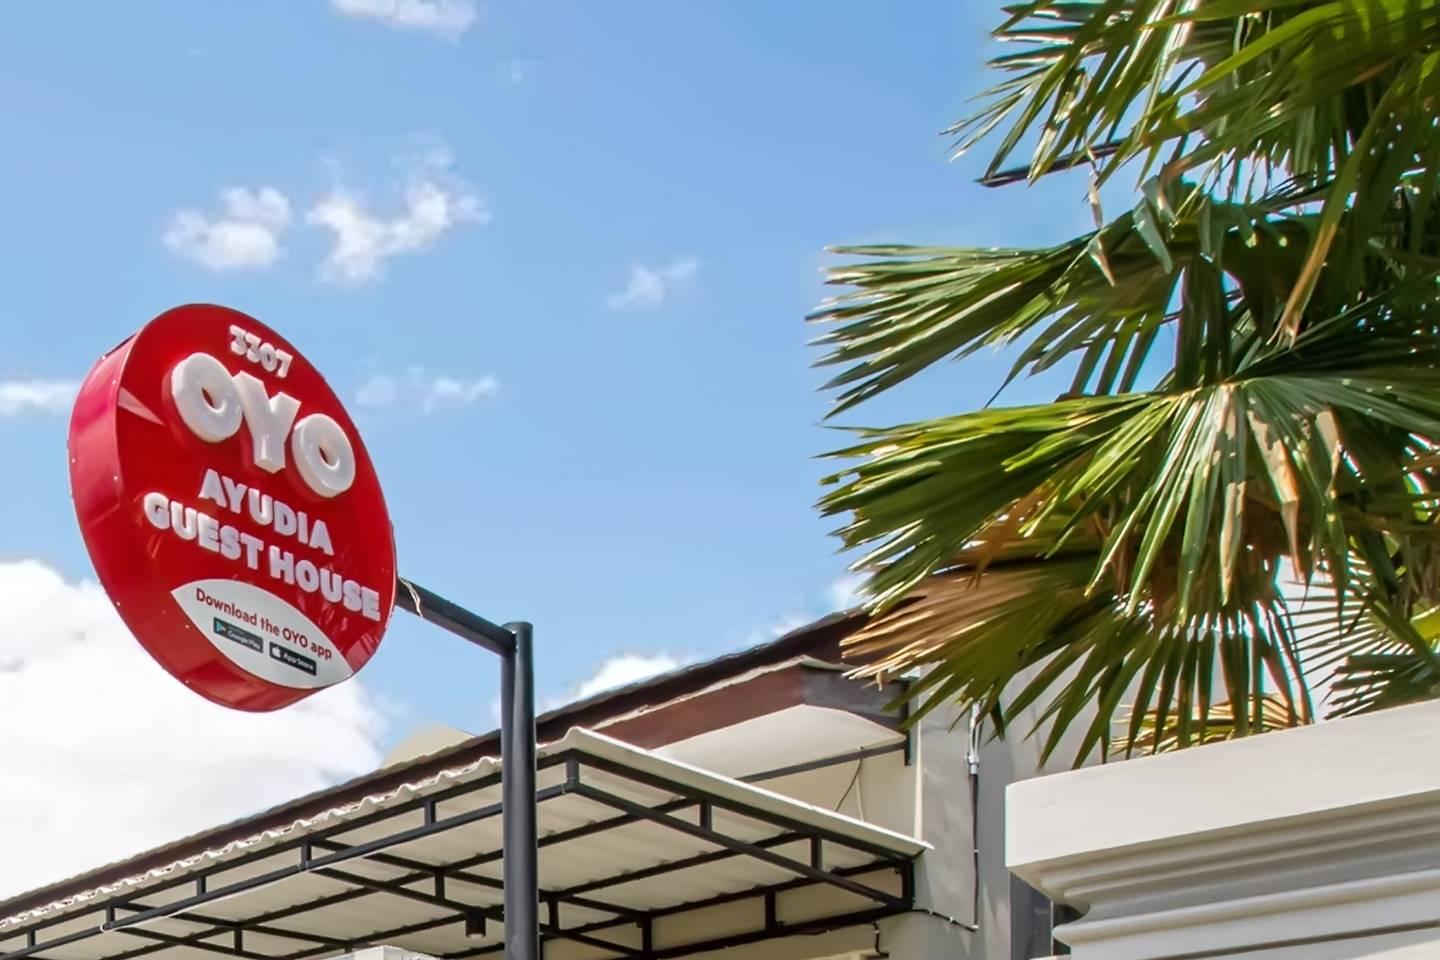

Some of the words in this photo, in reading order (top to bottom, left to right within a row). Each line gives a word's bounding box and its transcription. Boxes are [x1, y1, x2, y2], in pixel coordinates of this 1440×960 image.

[230, 325, 293, 378] 3307
[171, 352, 356, 498] OYO
[198, 468, 334, 556] AYUDIA
[144, 492, 264, 570] GUEST
[269, 545, 380, 622] HOUSE
[196, 587, 257, 626] Download
[261, 617, 280, 637] the
[282, 628, 308, 648] OYO
[311, 642, 332, 660] app
